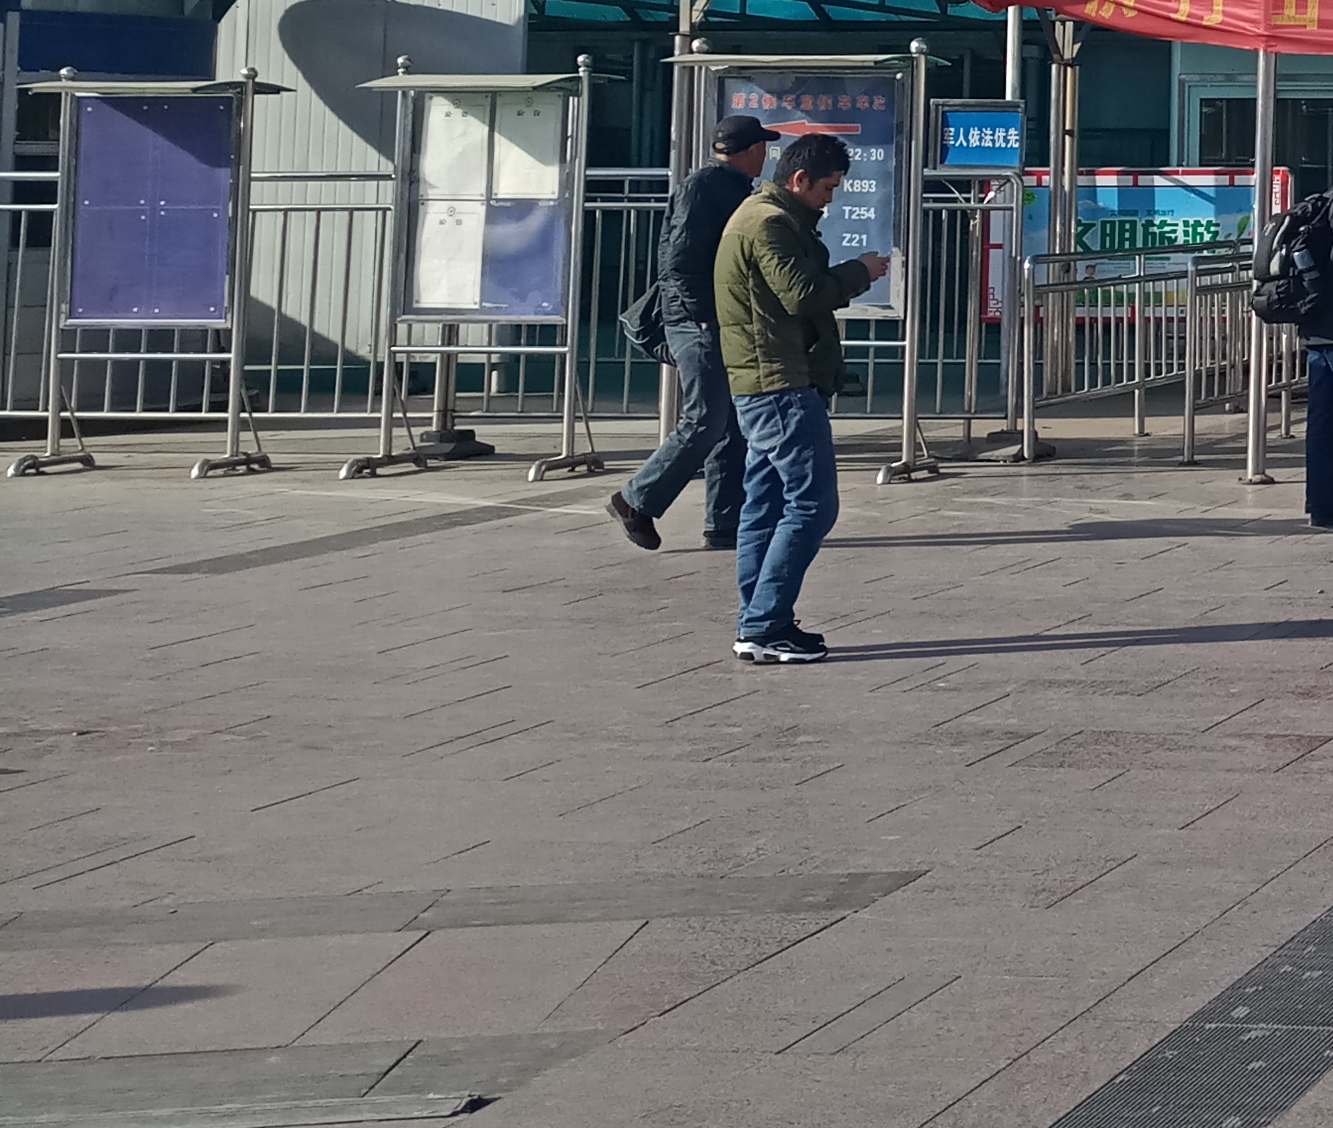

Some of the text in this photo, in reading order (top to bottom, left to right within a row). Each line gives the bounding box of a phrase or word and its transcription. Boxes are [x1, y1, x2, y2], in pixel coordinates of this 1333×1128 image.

[943, 127, 1020, 149] 军人依法优先
[843, 180, 877, 193] K893
[842, 206, 876, 220] T254
[842, 233, 868, 246] Z21
